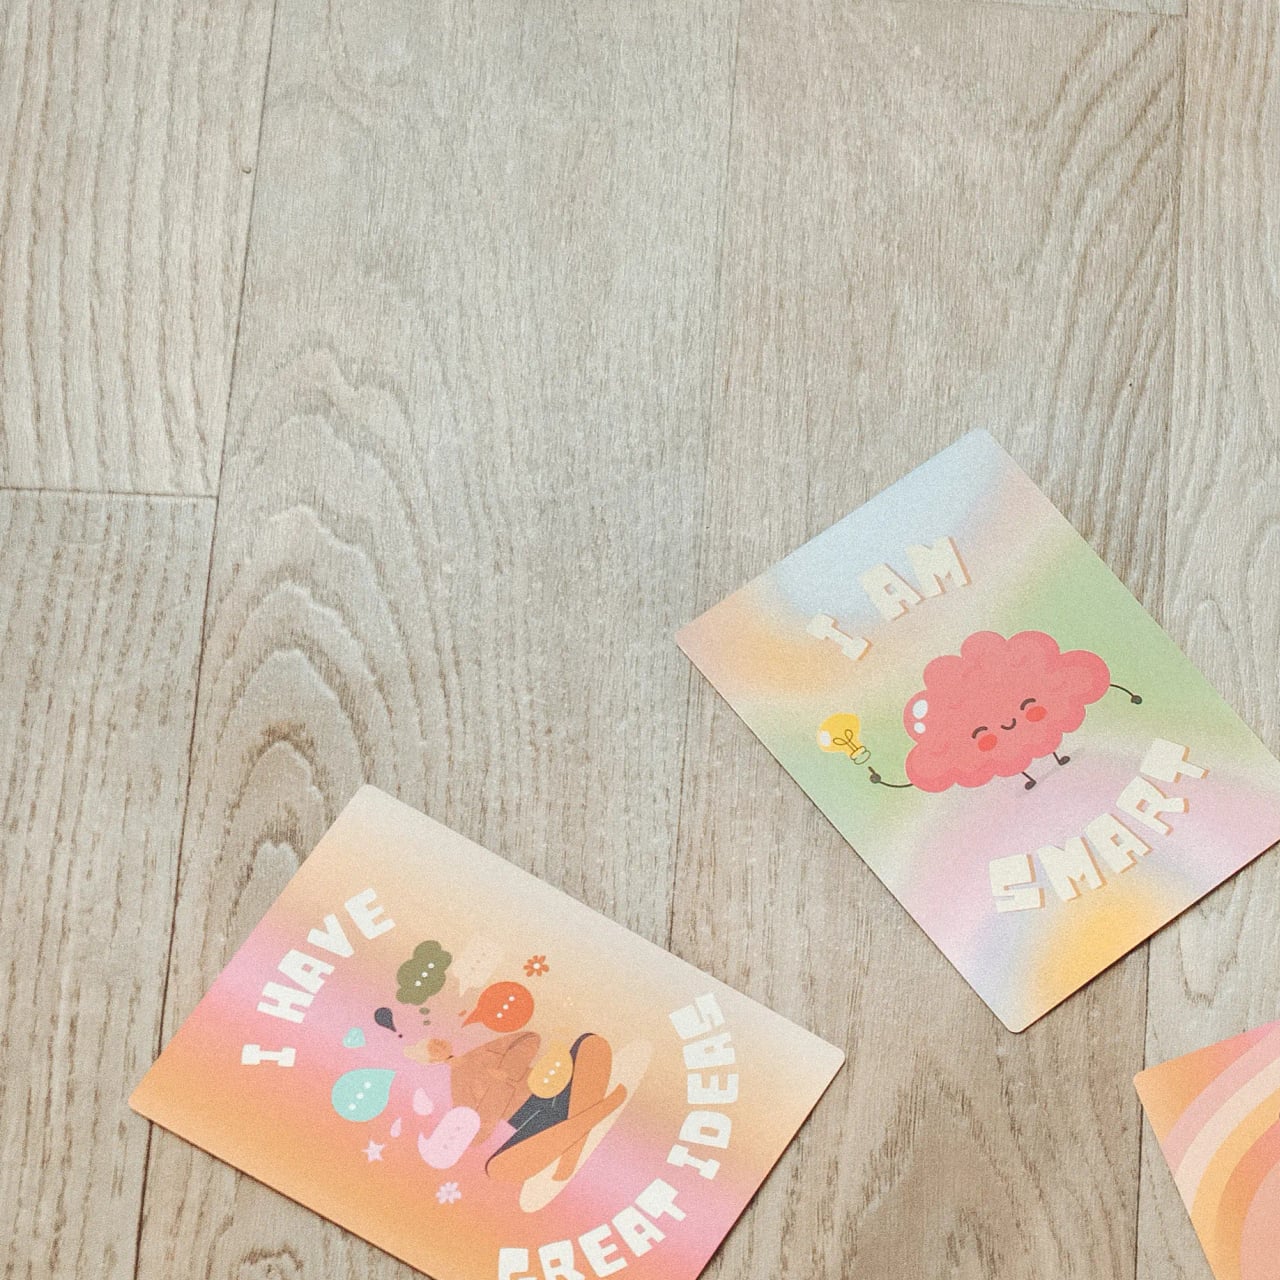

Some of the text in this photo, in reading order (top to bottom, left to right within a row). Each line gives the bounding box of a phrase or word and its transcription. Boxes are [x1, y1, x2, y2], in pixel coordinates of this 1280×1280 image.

[806, 536, 972, 660] I AM
[988, 737, 1210, 913] SMART
[241, 889, 395, 1068] I HAVE
[667, 993, 739, 1179] IDEAS
